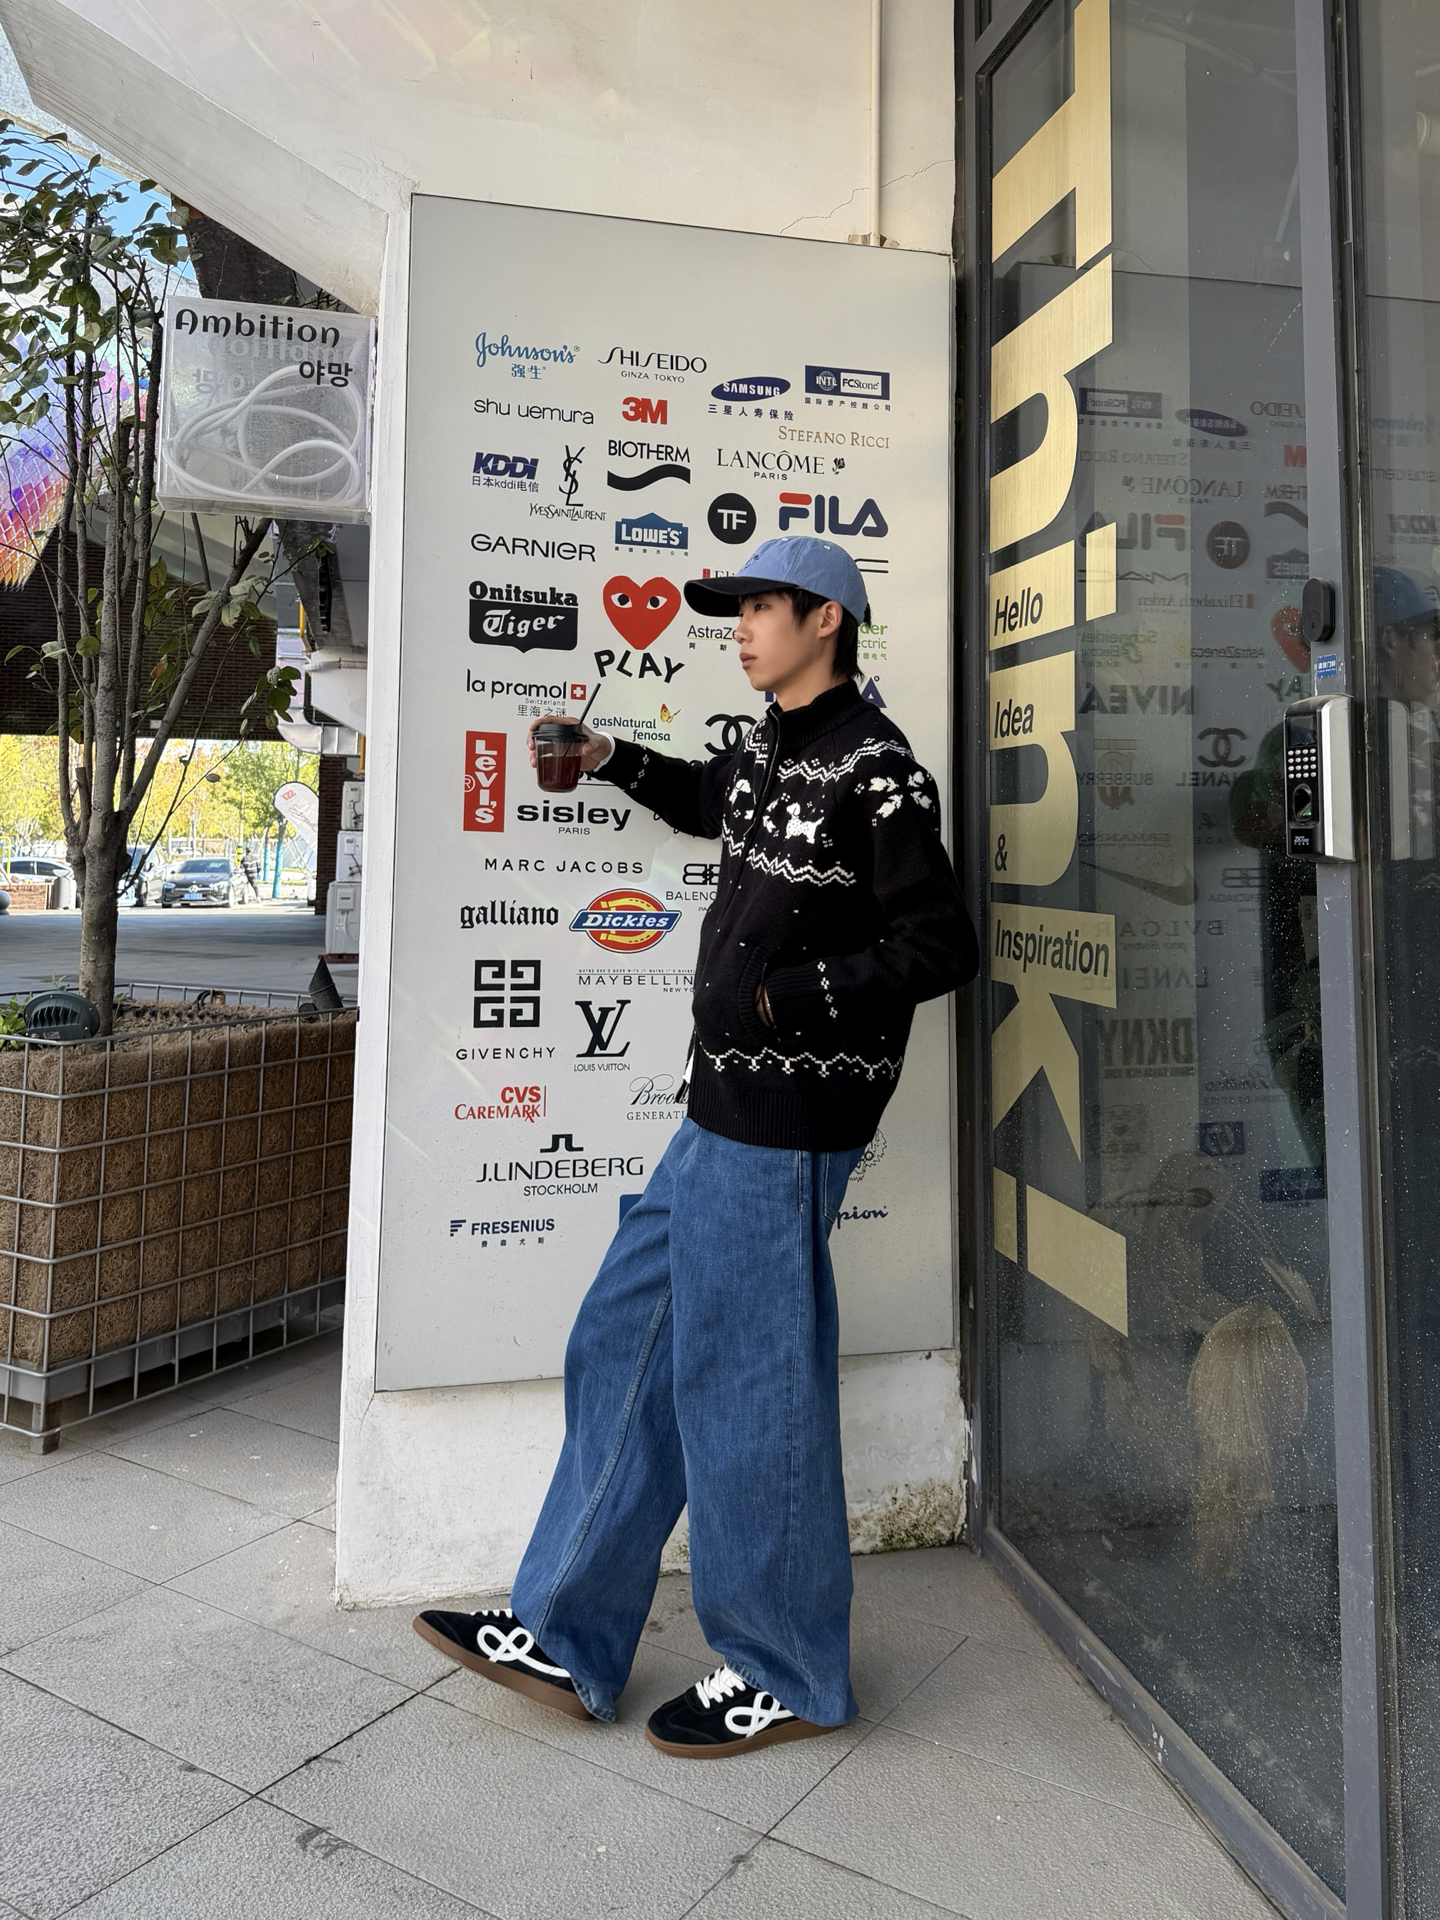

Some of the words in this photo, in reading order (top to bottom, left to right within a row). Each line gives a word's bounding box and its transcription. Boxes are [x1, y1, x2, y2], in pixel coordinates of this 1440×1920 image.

[175, 308, 340, 348] Ambition
[598, 346, 708, 374] SHISEIDO
[299, 360, 353, 388] 야망
[621, 370, 650, 380] GINZA
[653, 373, 685, 383] TOKYO
[723, 381, 780, 397] SAMSUNG
[474, 398, 511, 416] shu
[518, 403, 594, 425] uemura
[621, 397, 668, 425] 3M
[708, 403, 794, 421] 三星人寿保险
[778, 426, 846, 446] STEFANO
[850, 431, 890, 449] RICCI
[608, 439, 690, 463] BIOTHERM
[717, 448, 825, 475] LANCÔME
[473, 452, 539, 480] KDDI
[753, 471, 788, 481] PARIS
[779, 491, 889, 539] FILA
[621, 523, 683, 546] LOWE'S
[470, 533, 596, 562] GARNIER
[469, 580, 579, 606] Onitsuka
[994, 586, 1043, 636] Hello
[482, 609, 565, 637] Tiger
[687, 624, 737, 640] AstraZ
[594, 649, 685, 683] PLAY
[466, 668, 486, 693] la
[491, 681, 567, 699] pramol
[525, 697, 566, 706] Switzerland
[592, 716, 657, 730] gasNatural
[994, 698, 1035, 739] Idea
[632, 729, 671, 742] fenosa
[517, 800, 632, 831] sisley
[558, 826, 591, 835] PARIS
[994, 833, 1007, 872] &
[485, 858, 546, 872] MARC
[556, 860, 644, 874] JACOBS
[665, 891, 717, 901] BALENC
[460, 899, 559, 929] galliano
[582, 914, 670, 928] Dickies
[995, 918, 1111, 979] Inspiration
[578, 975, 693, 986] MAYBELLIN
[456, 1047, 556, 1060] GIVENCHY
[574, 1063, 596, 1072] LOUIS
[597, 1062, 630, 1072] VUITTON
[501, 1086, 541, 1104] CVS
[626, 1111, 685, 1121] GENERATI
[476, 1157, 644, 1183] J.LINDEBERG
[523, 1183, 598, 1197] STOCKHOLM
[471, 1218, 555, 1235] FRESENIUS
